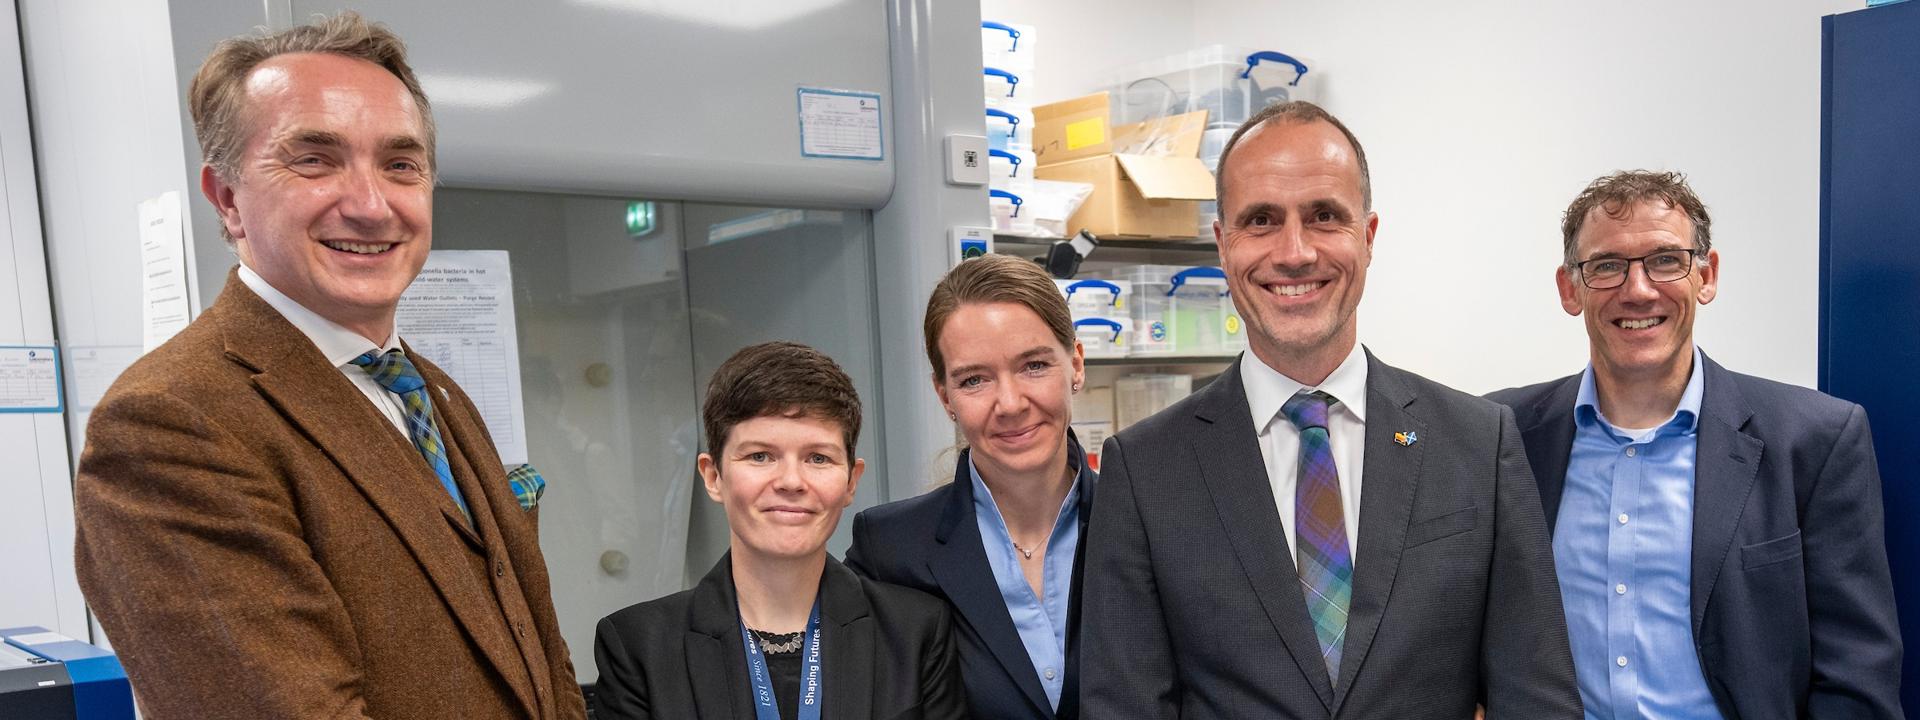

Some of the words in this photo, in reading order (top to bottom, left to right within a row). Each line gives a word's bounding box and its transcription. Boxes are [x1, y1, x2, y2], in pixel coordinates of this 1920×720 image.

[809, 628, 821, 663] Futures
[753, 658, 763, 682] Since
[758, 685, 772, 707] 1821
[805, 665, 819, 705] Shaping
